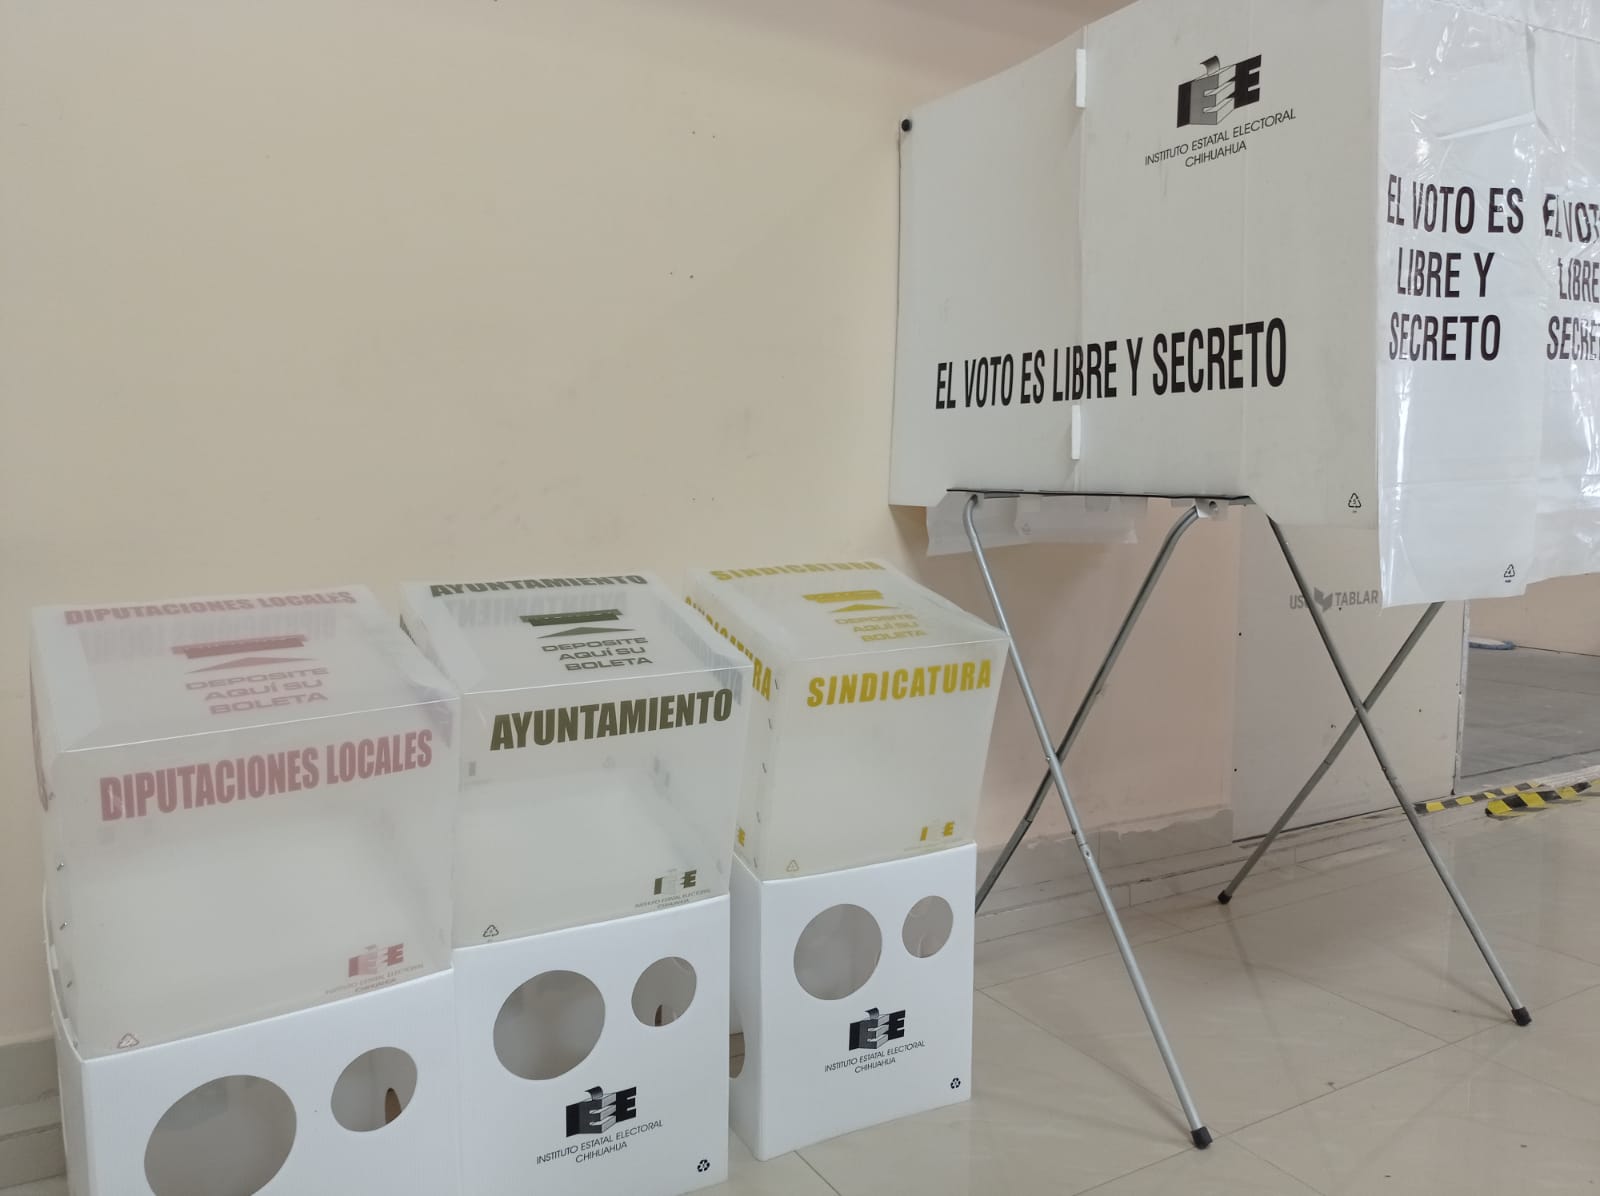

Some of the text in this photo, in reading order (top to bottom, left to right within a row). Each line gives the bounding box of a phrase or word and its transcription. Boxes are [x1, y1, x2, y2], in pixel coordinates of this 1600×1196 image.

[1144, 107, 1297, 166] INSTITUTO ESTATAL ELECTORAL
[1185, 140, 1247, 168] CHIHUAHUA
[1386, 173, 1525, 234] EL VOTO ES
[1397, 247, 1496, 298] LIBRE Y
[1389, 311, 1501, 361] SECRETO
[1546, 315, 1600, 361] SECRE
[935, 317, 1288, 410] EL VOTO ES LIBRE Y SECRETO
[429, 574, 649, 598] AYUNTAMIENTO
[710, 561, 887, 581] SINDICATURA
[64, 590, 357, 625] DIPUTACIONES LOCALES
[541, 637, 649, 652] DEPOSITE
[617, 646, 646, 655] SU
[185, 667, 330, 690] DEPOSITE
[565, 656, 653, 671] BOLETA
[283, 678, 323, 689] SU
[806, 659, 992, 708] SINDICATURA
[209, 692, 329, 716] BOLETA
[489, 688, 734, 751] AYUNTAMIENTO
[100, 729, 433, 822] DIPUTACIONES LOCALES
[824, 1039, 926, 1073] INSTITUTO ESTATAL ELECTORAL
[854, 1056, 897, 1074] CHIHUAHUA
[536, 1119, 664, 1165] INSTITUTO ESTATAL ELECTORAL
[575, 1141, 628, 1164] CHIHUAHUA
